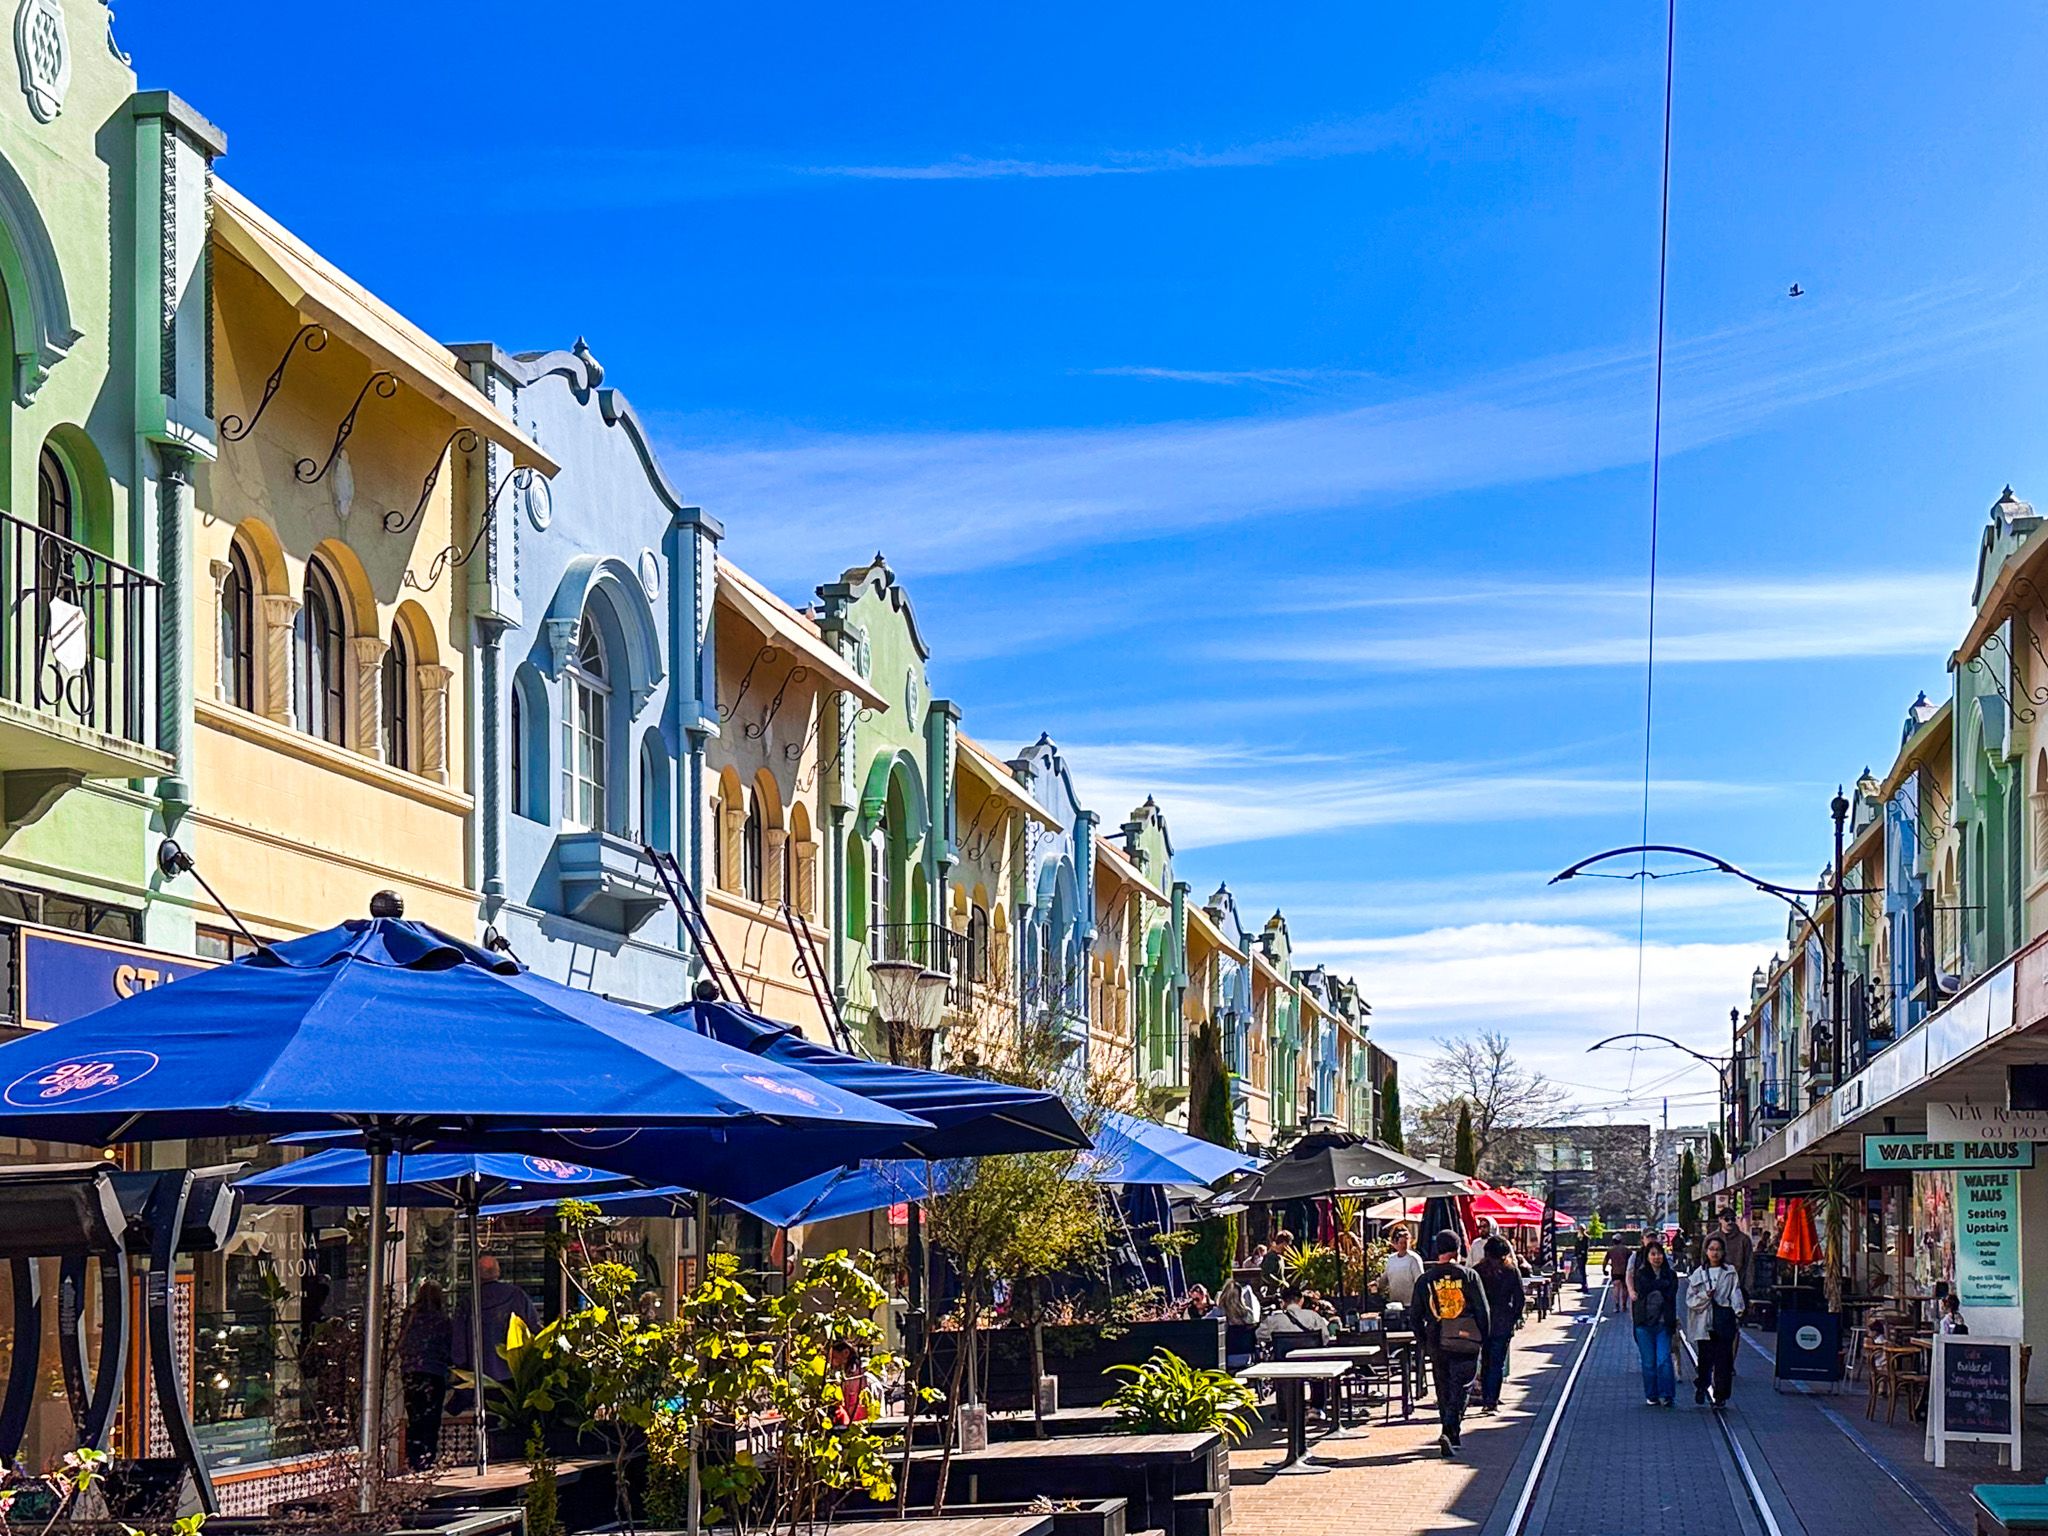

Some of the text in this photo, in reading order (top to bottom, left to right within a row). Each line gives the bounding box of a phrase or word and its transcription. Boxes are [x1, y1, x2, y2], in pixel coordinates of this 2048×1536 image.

[1878, 1142, 2020, 1160] WAFFLE HAUS
[1964, 1174, 2009, 1187] WAFFLE
[1970, 1189, 2003, 1202] HAUS
[1967, 1207, 2007, 1220] Seating
[1966, 1222, 2009, 1234] Upstairs
[258, 1259, 317, 1277] WATSON
